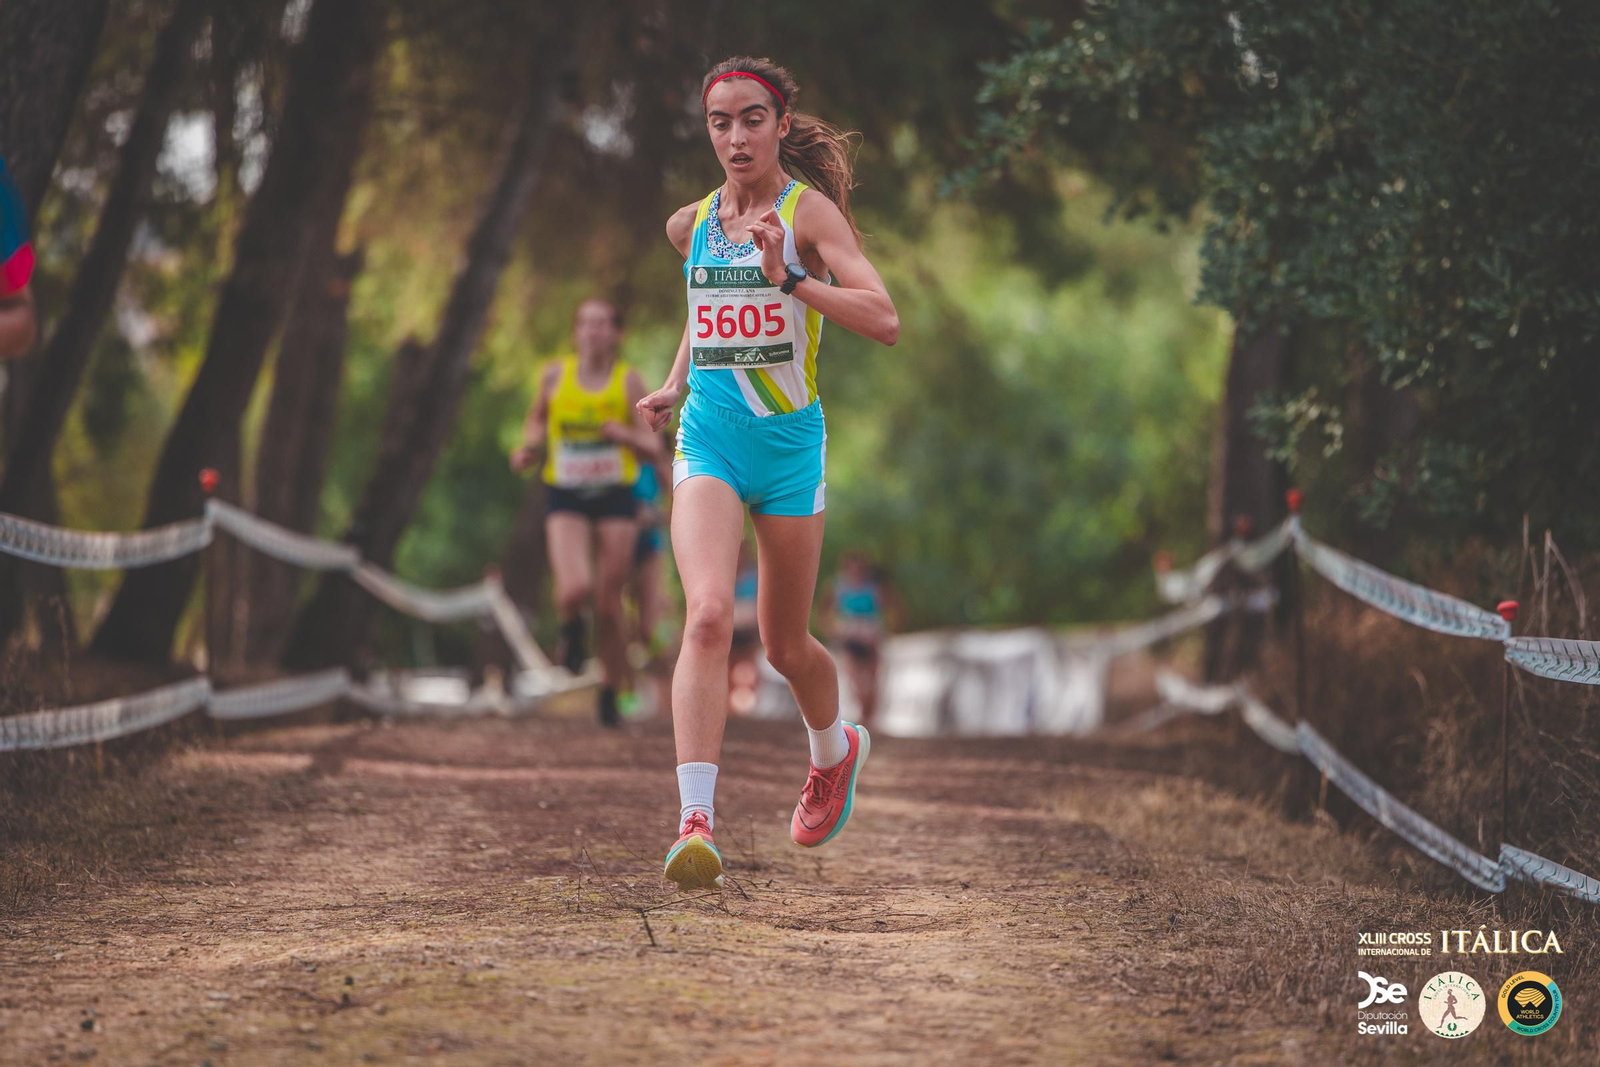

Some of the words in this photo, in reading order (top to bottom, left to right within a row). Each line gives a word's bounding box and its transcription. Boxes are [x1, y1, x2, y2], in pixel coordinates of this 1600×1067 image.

[715, 268, 760, 281] ITÁLICA
[697, 303, 786, 339] 5605
[834, 760, 851, 800] HOKA
